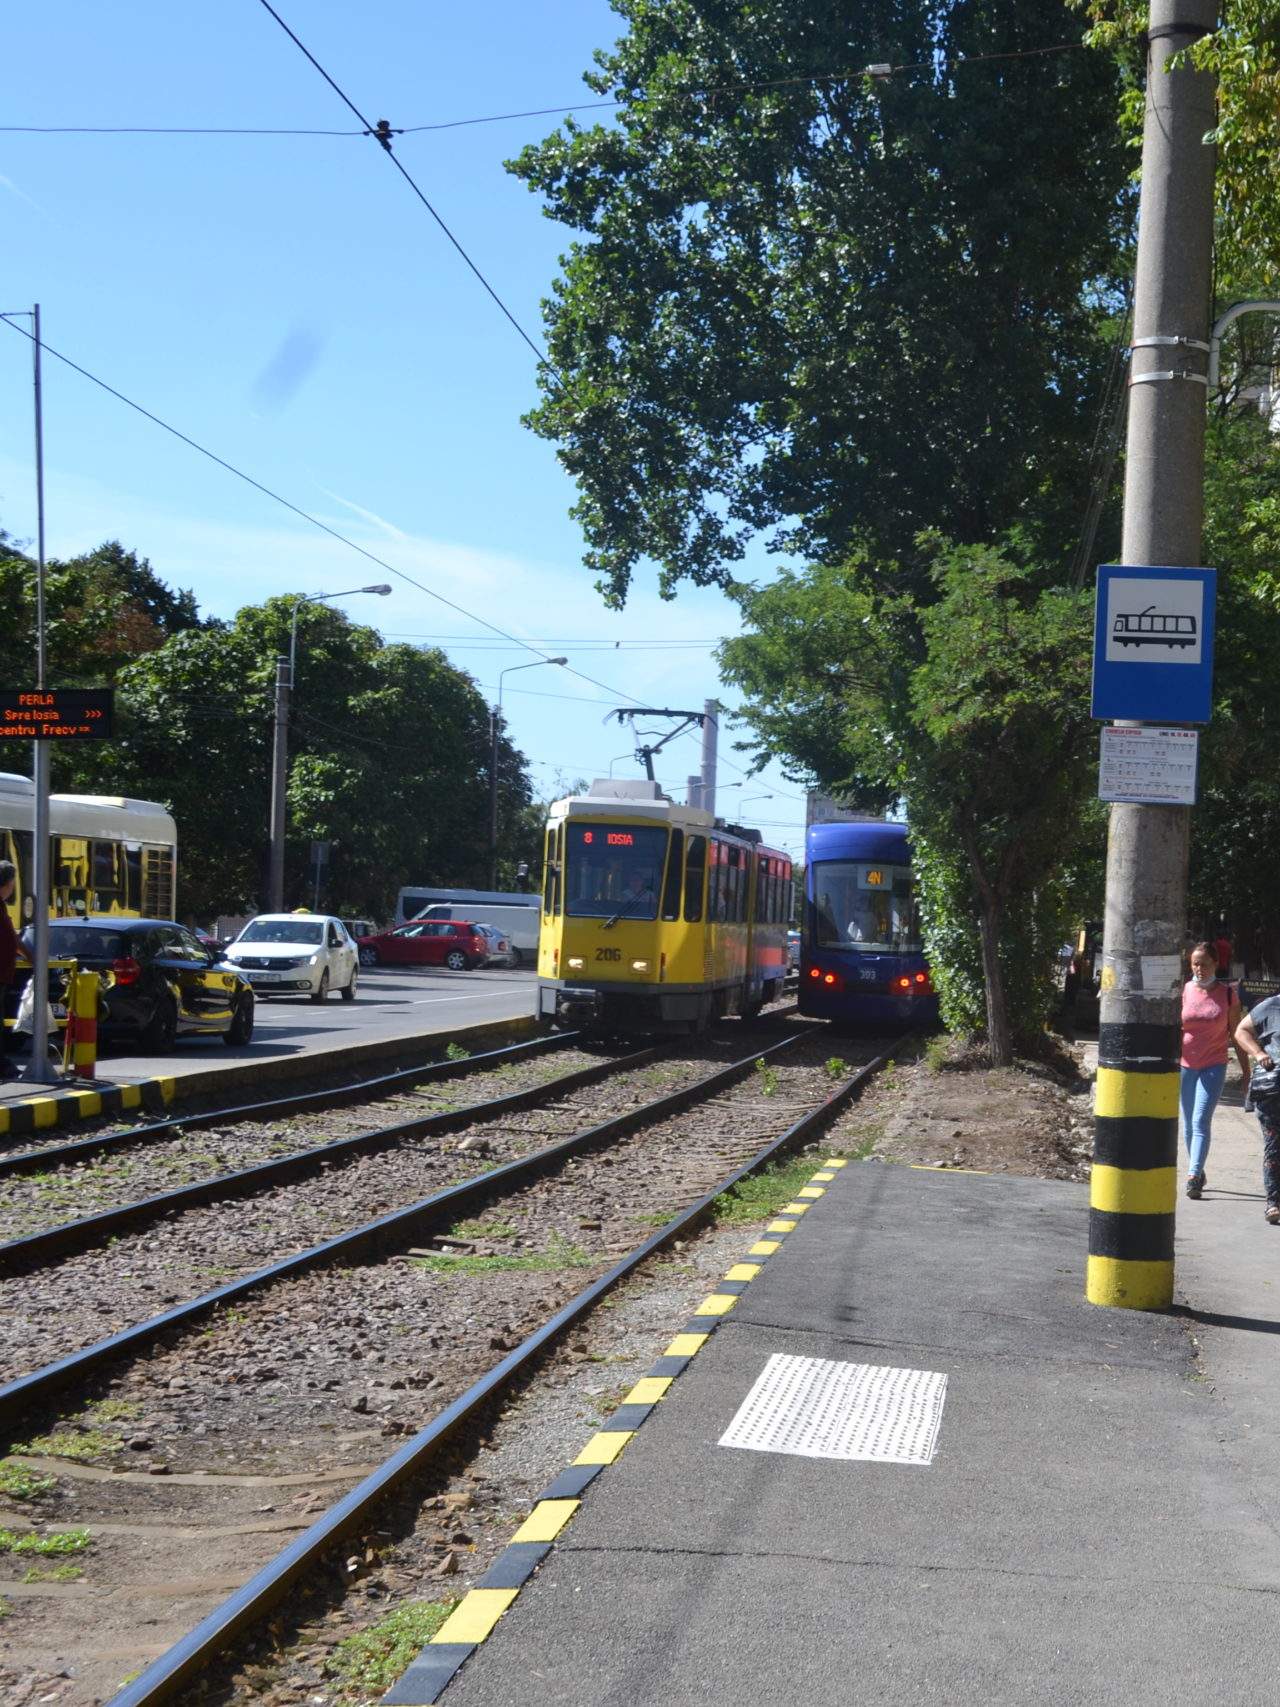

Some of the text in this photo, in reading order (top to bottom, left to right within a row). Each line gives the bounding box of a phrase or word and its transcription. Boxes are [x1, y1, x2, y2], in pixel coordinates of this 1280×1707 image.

[19, 694, 54, 706] PERLA
[583, 832, 633, 846] 8 IOSIA
[595, 948, 621, 962] 206
